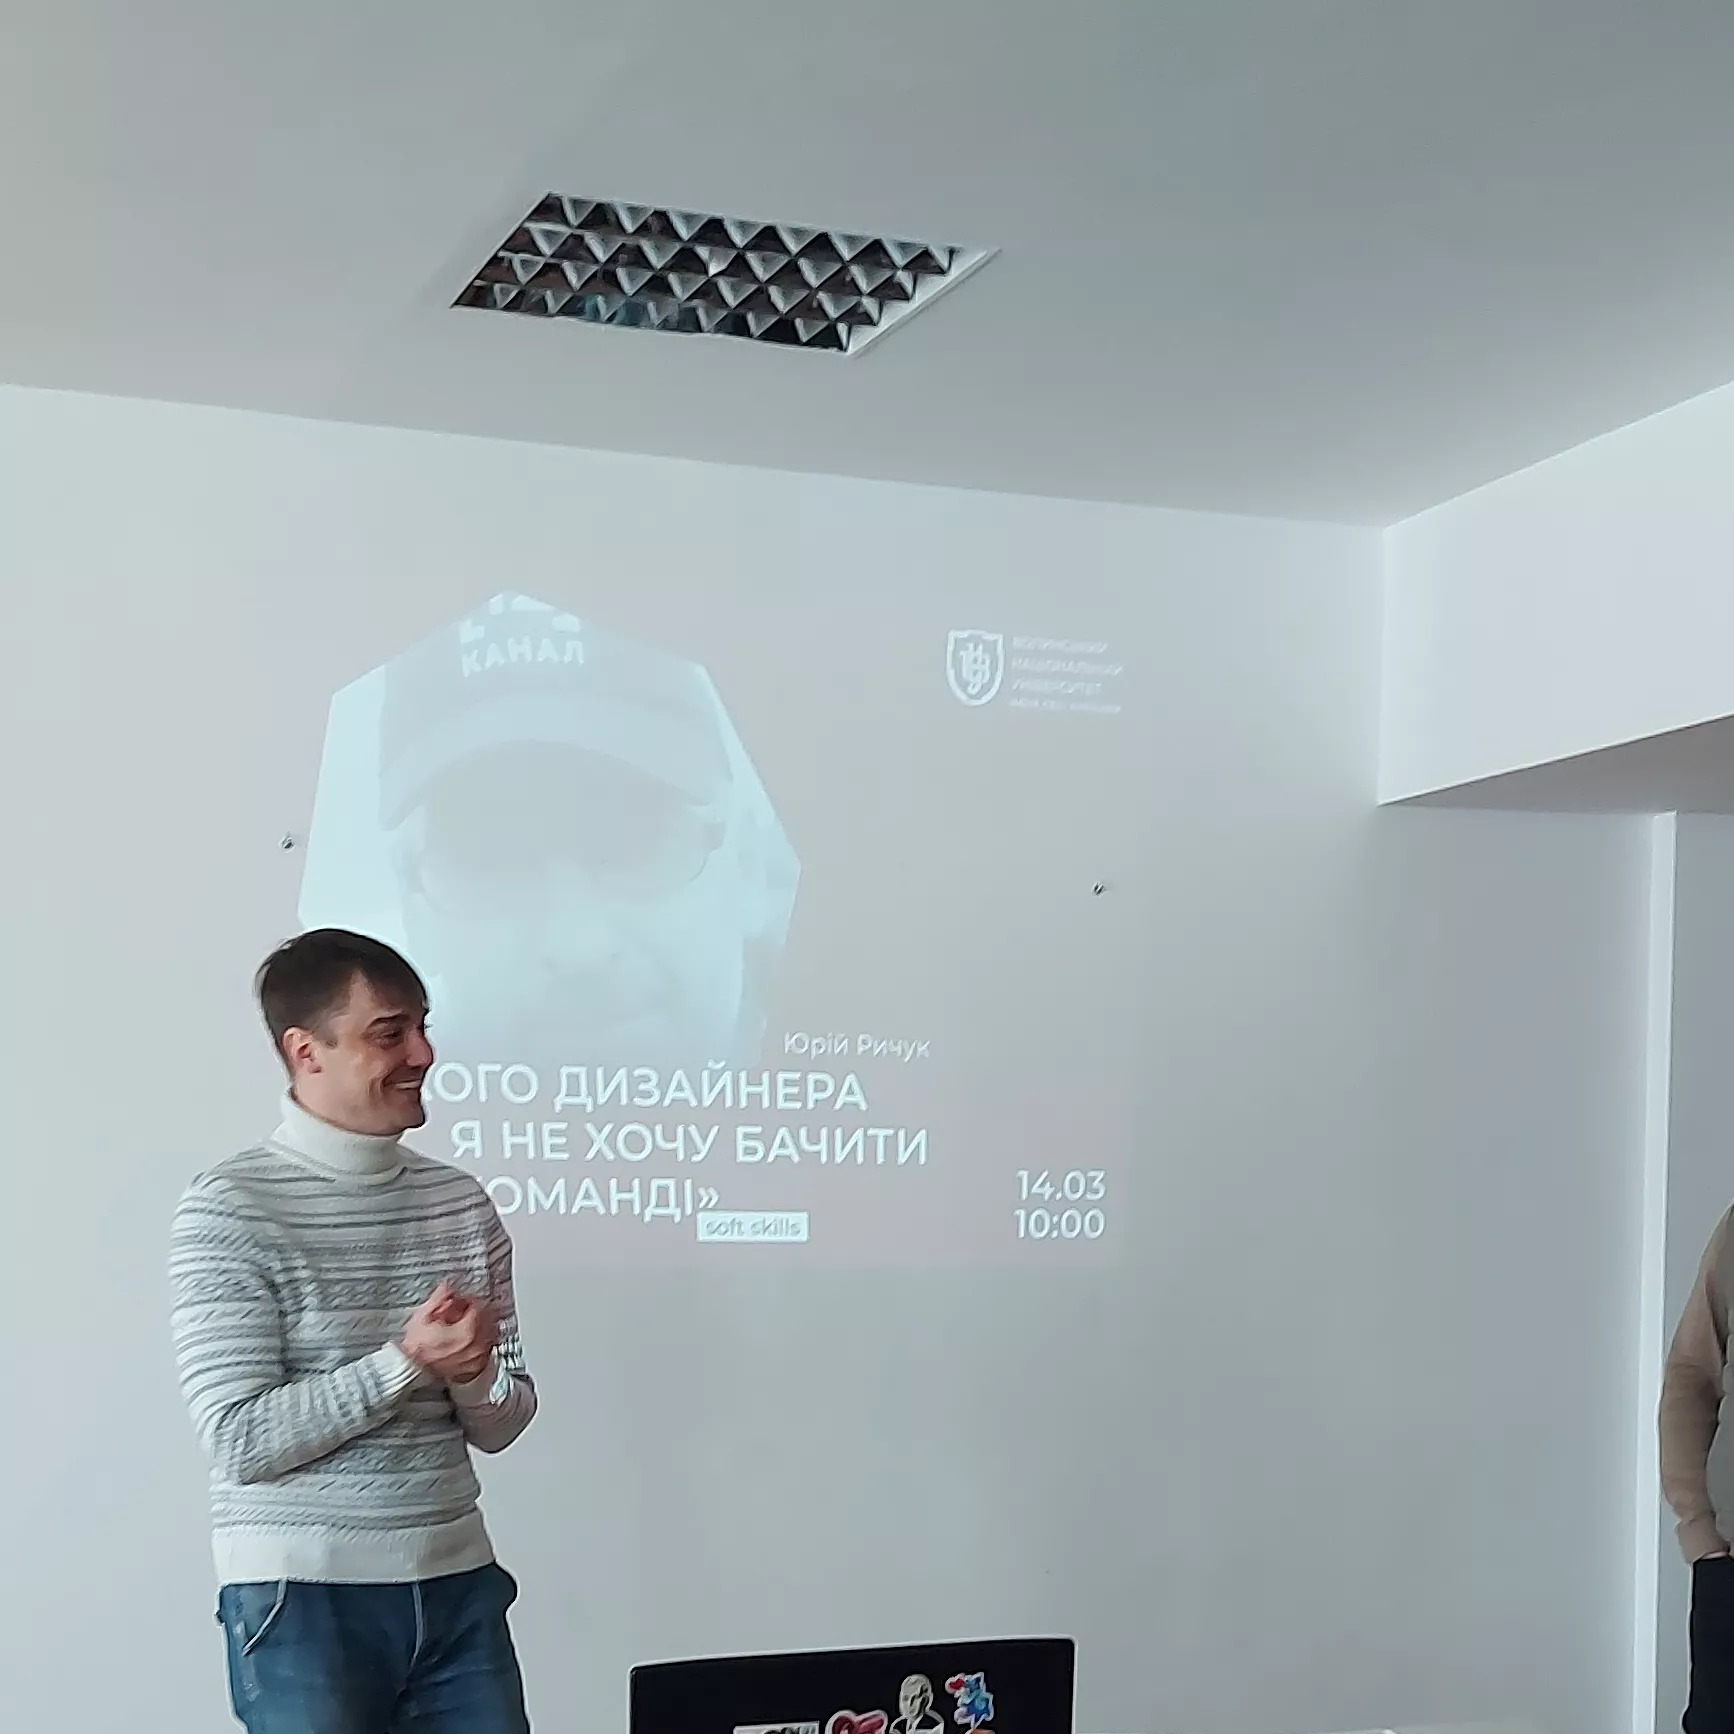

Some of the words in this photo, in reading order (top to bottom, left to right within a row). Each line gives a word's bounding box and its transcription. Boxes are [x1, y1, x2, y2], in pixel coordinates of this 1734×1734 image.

[461, 635, 585, 679] КАНАЛ
[784, 1032, 849, 1061] Юрій
[856, 1034, 931, 1063] Ричук
[423, 1061, 540, 1105] ОГО
[553, 1060, 869, 1113] ДИЗАЙНЕРА
[449, 1119, 484, 1161] Я
[501, 1120, 570, 1161] НЕ
[584, 1121, 719, 1164] ХОЧУ
[734, 1124, 929, 1166] БАЧИТИ
[478, 1175, 721, 1224] ОМАНДІ»
[1016, 1168, 1107, 1203] 14.03
[706, 1217, 744, 1236] soft
[750, 1216, 801, 1236] skills
[1012, 1207, 1106, 1241] 10:00
